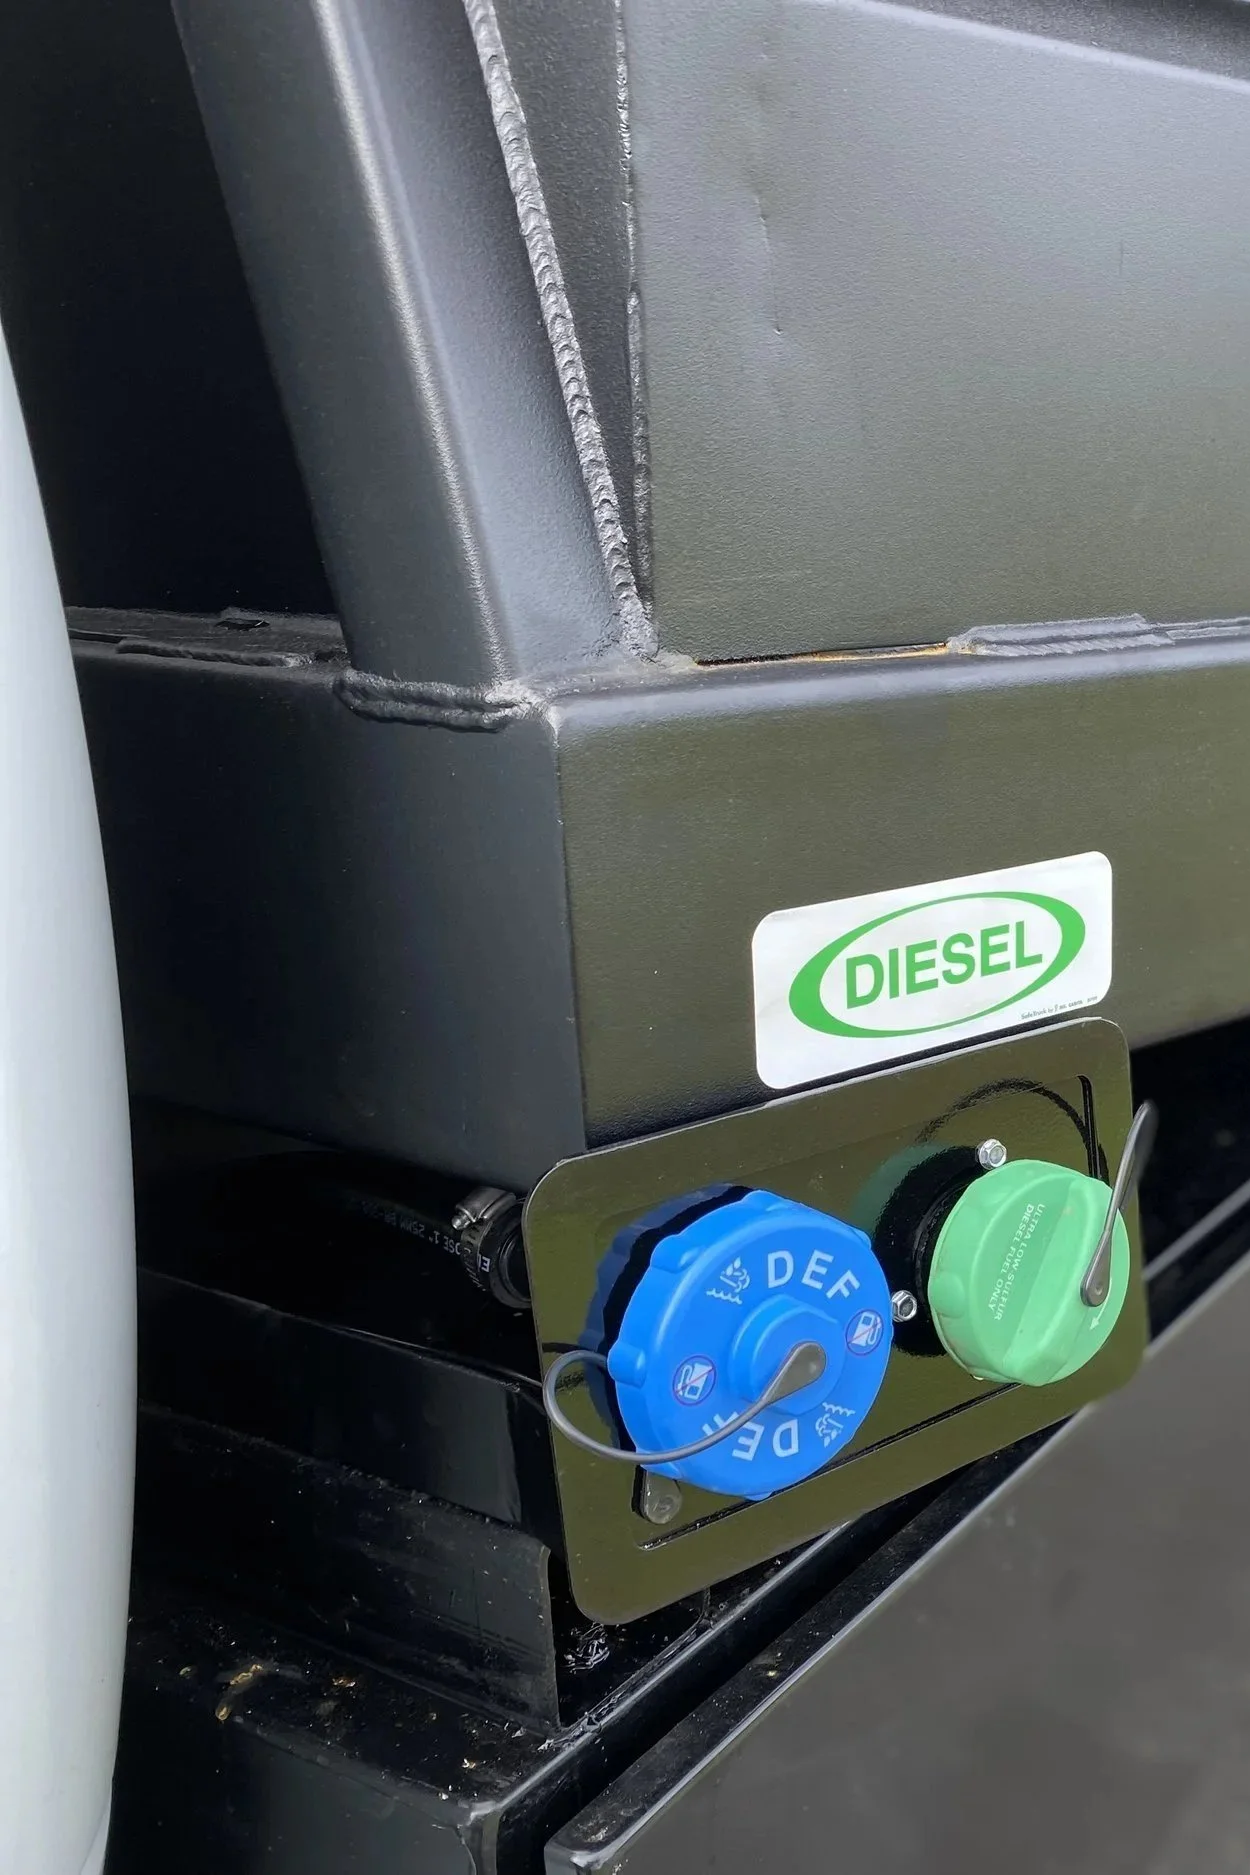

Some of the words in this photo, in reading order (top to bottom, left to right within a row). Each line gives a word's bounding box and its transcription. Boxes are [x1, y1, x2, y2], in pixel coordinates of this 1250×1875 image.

[846, 921, 1043, 1009] DIESEL
[1013, 1203, 1035, 1242] DIESEL
[1024, 1203, 1045, 1240] ULTRA
[767, 1250, 860, 1299] DEF
[1000, 1246, 1016, 1274] FUEL
[1012, 1242, 1027, 1271] LOW
[988, 1279, 1004, 1313] ONLY
[994, 1273, 1015, 1321] SULFUR
